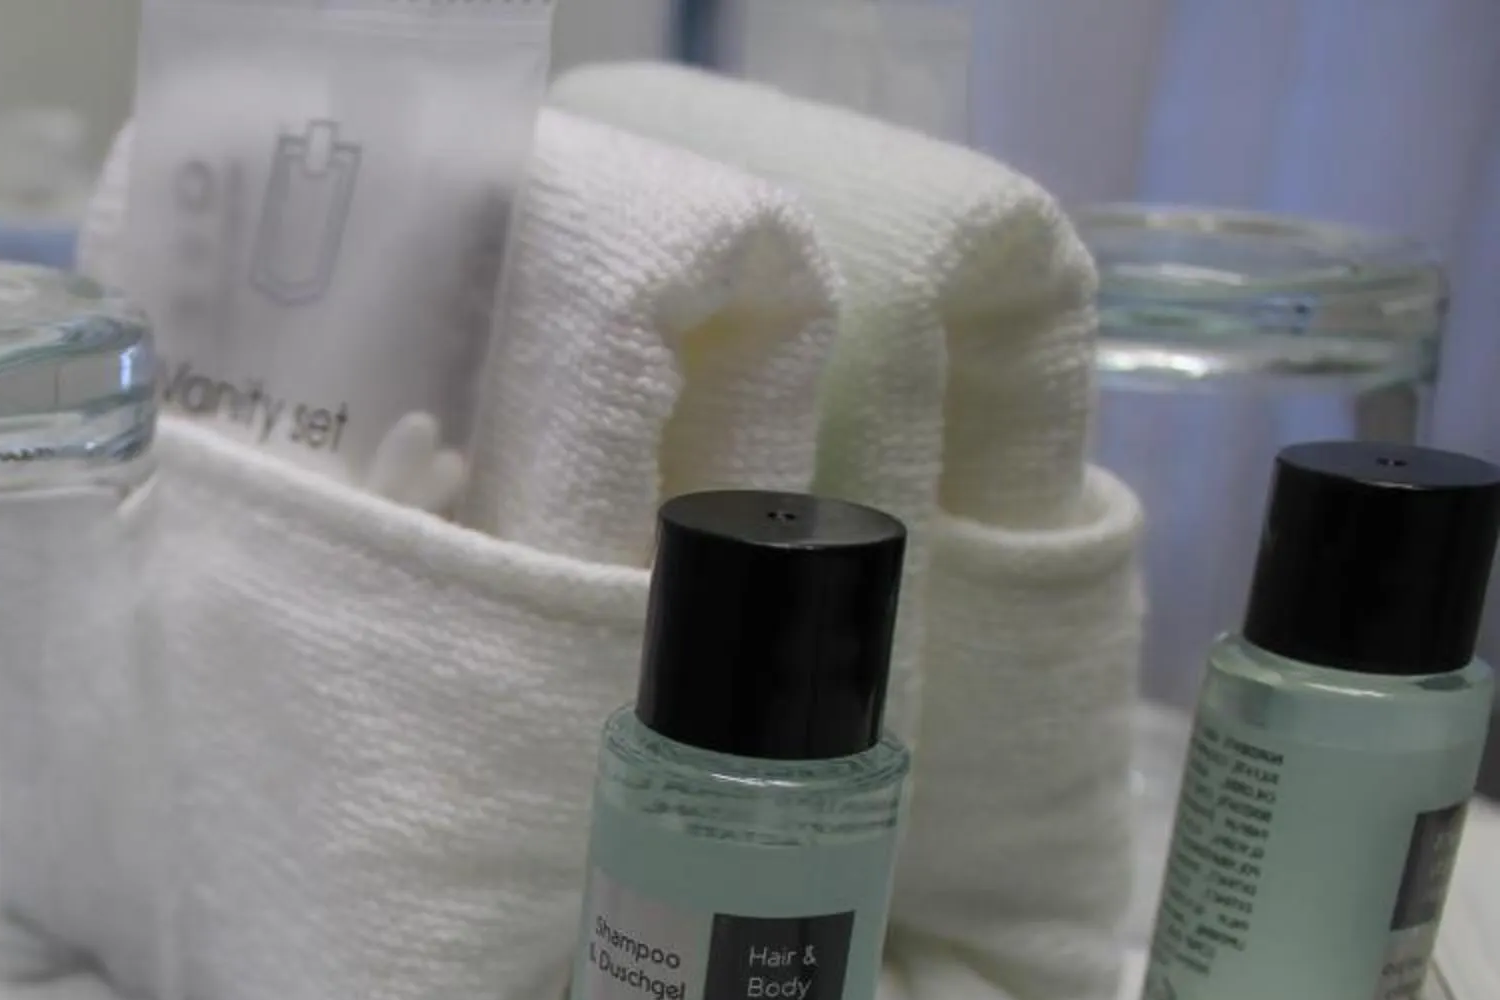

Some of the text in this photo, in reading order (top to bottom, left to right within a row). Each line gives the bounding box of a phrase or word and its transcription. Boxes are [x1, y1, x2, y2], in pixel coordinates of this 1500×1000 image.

[290, 401, 349, 452] set
[595, 915, 682, 970] Shampoo
[748, 943, 819, 968] Hair &
